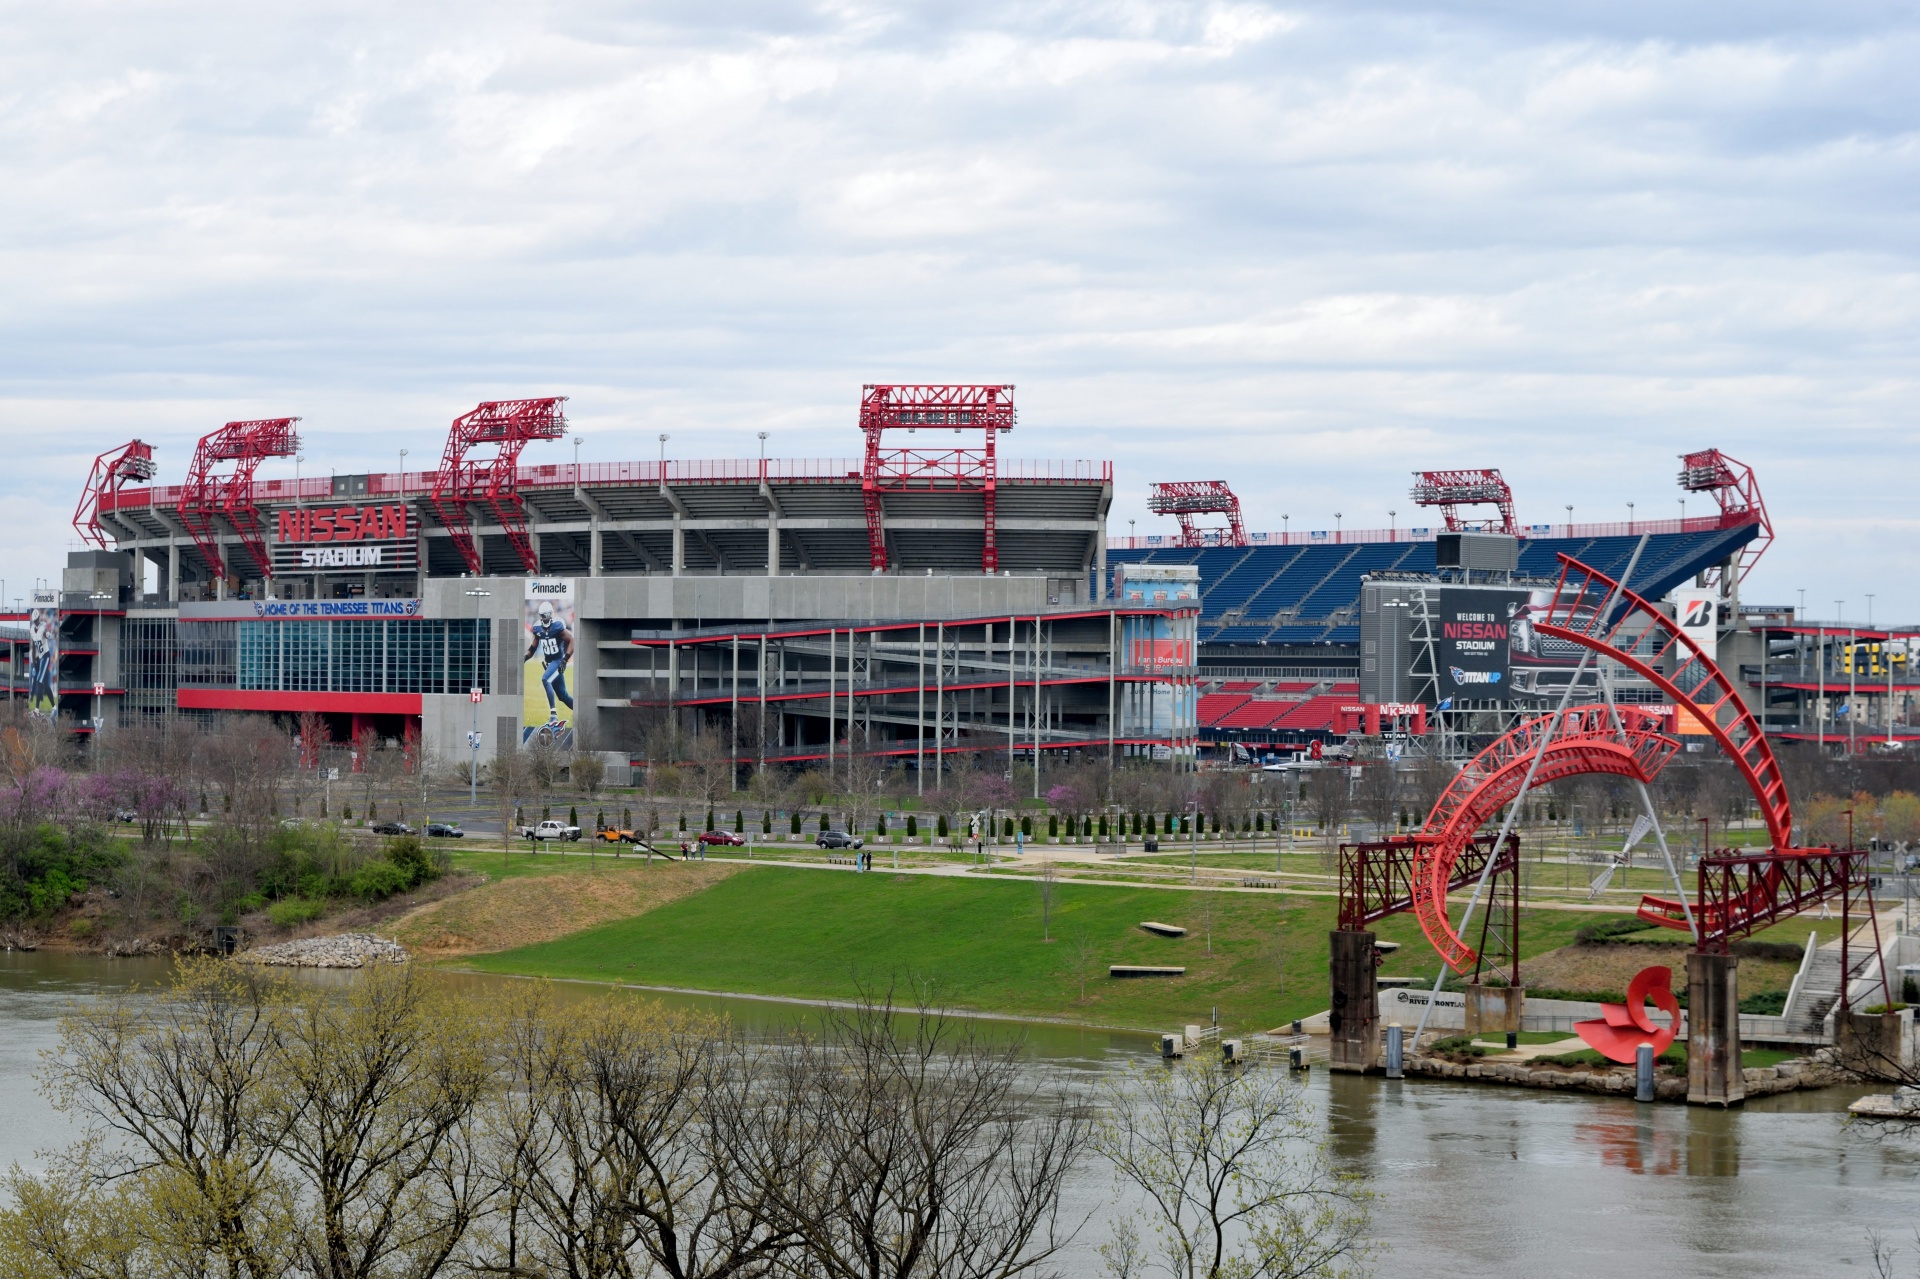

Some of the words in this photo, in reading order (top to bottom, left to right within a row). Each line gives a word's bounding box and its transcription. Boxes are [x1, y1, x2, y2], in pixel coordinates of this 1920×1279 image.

[278, 504, 407, 543] NISSAN
[301, 546, 382, 567] STADIUM
[532, 582, 567, 594] Pinnacle
[34, 593, 54, 603] Pinnacle
[265, 603, 287, 615] HOME
[289, 603, 300, 615] OF
[303, 603, 318, 615] THE
[320, 602, 368, 615] TENNESSEE
[371, 602, 404, 614] TITANS
[1457, 613, 1485, 621] WELCOME
[1488, 613, 1495, 622] TO
[1444, 623, 1507, 639] NISSAN
[1456, 641, 1495, 650] STADIUM
[1158, 656, 1183, 664] Bureau
[95, 686, 103, 695] H
[472, 692, 481, 702] H
[1380, 704, 1419, 715] NSAN
[1389, 707, 1397, 716] K
[1310, 739, 1322, 760] 8
[1843, 738, 1867, 753] 10
